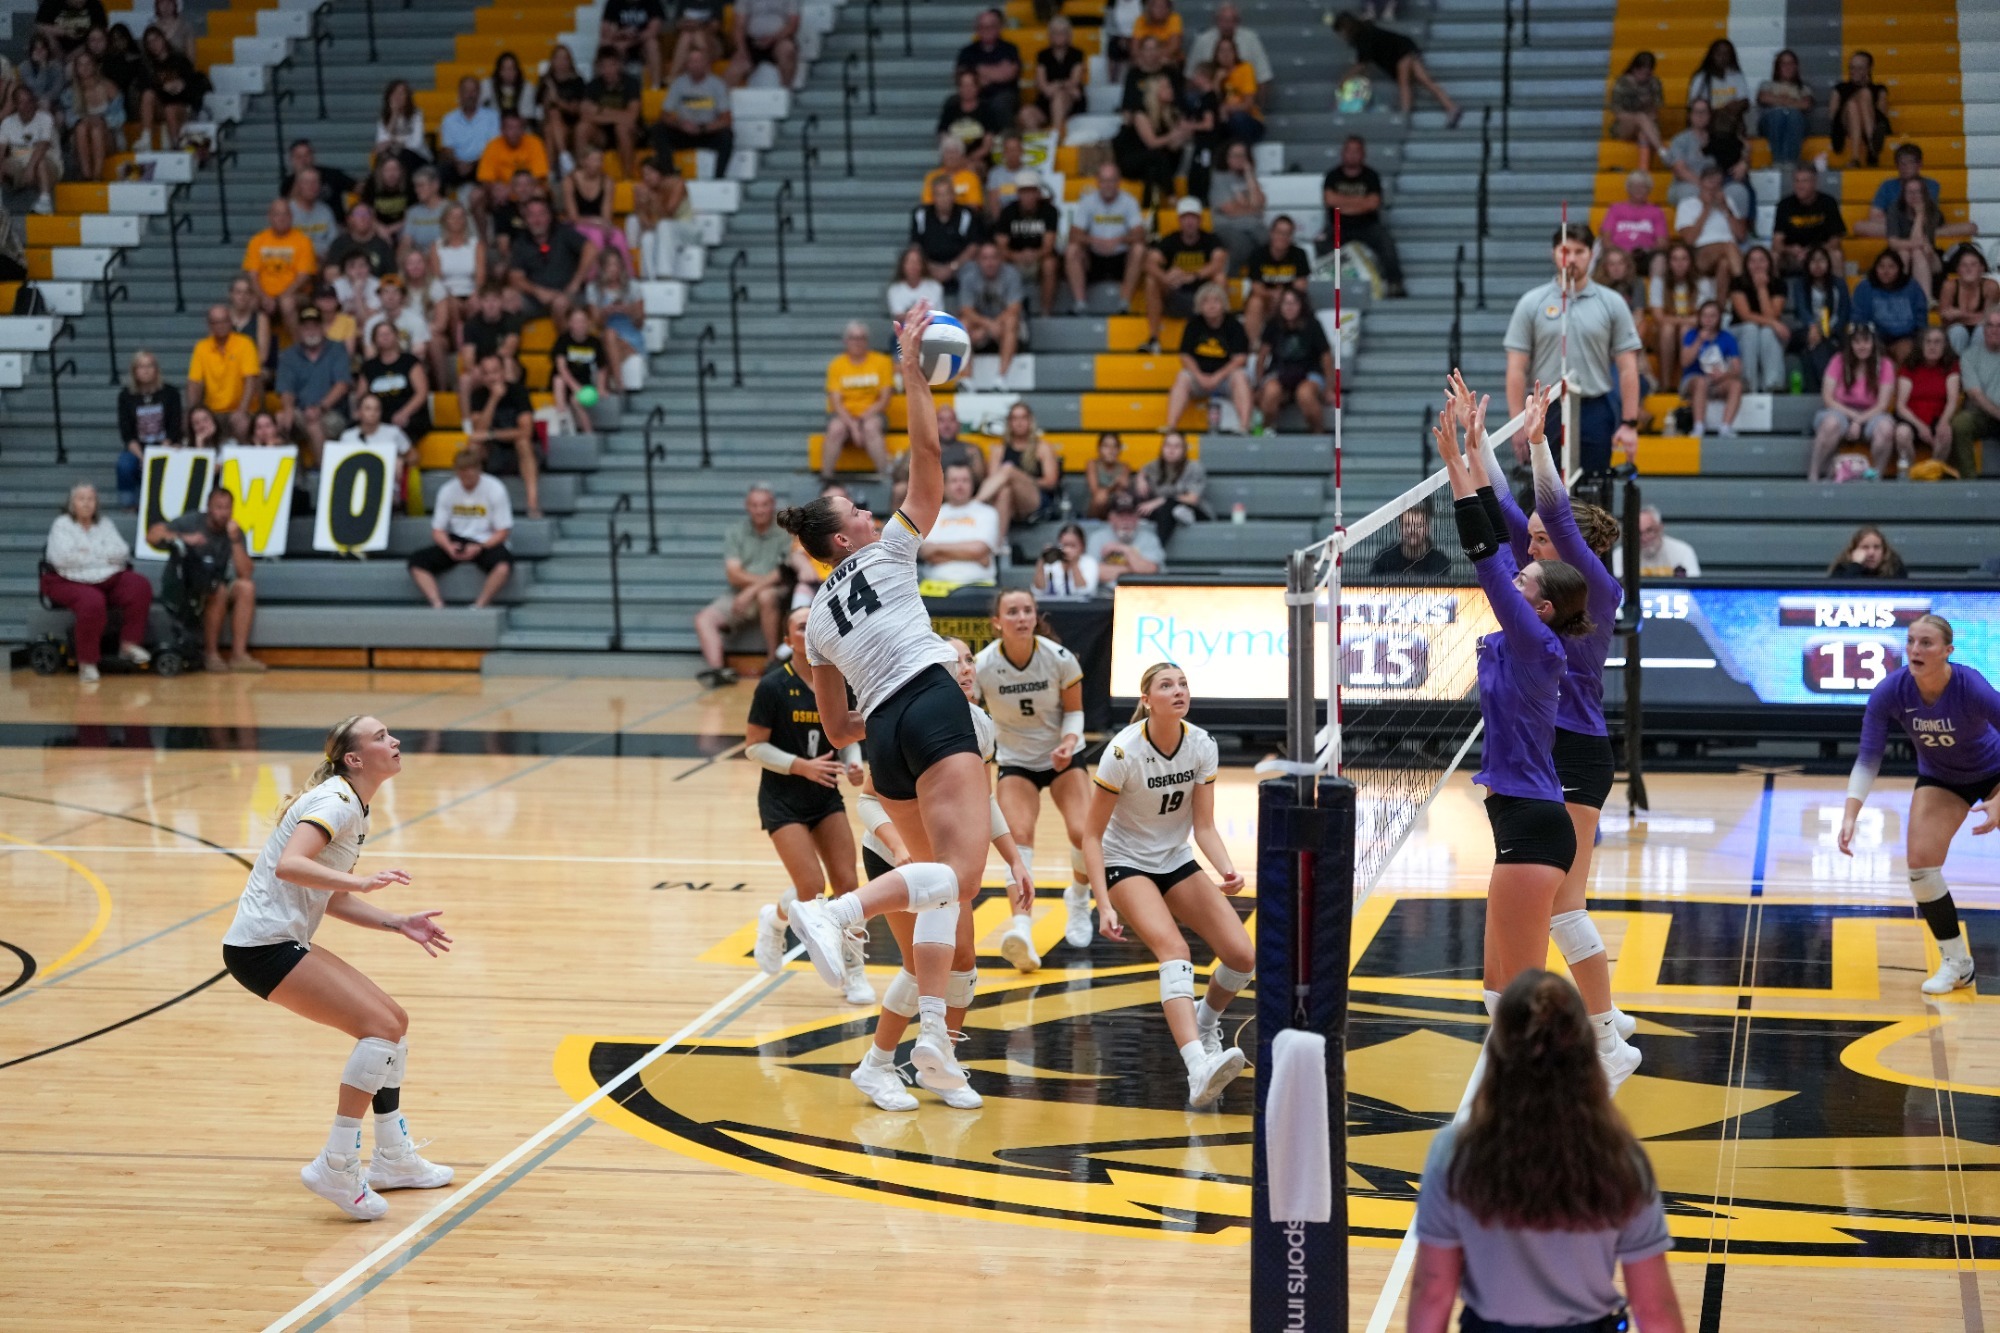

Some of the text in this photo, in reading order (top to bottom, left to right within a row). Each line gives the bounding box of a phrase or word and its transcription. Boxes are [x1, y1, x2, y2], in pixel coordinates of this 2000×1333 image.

[145, 455, 209, 553] U
[222, 456, 295, 555] W
[828, 570, 882, 637] 14
[1330, 596, 1451, 623] ITANS
[1815, 602, 1896, 628] RAMS
[1350, 636, 1415, 685] 15
[1819, 641, 1887, 690] 13
[999, 680, 1048, 695] OSHKOSH
[1020, 699, 1035, 716] 5
[1912, 717, 1956, 732] CORNELL
[1920, 734, 1956, 748] 20
[1158, 791, 1185, 815] 19
